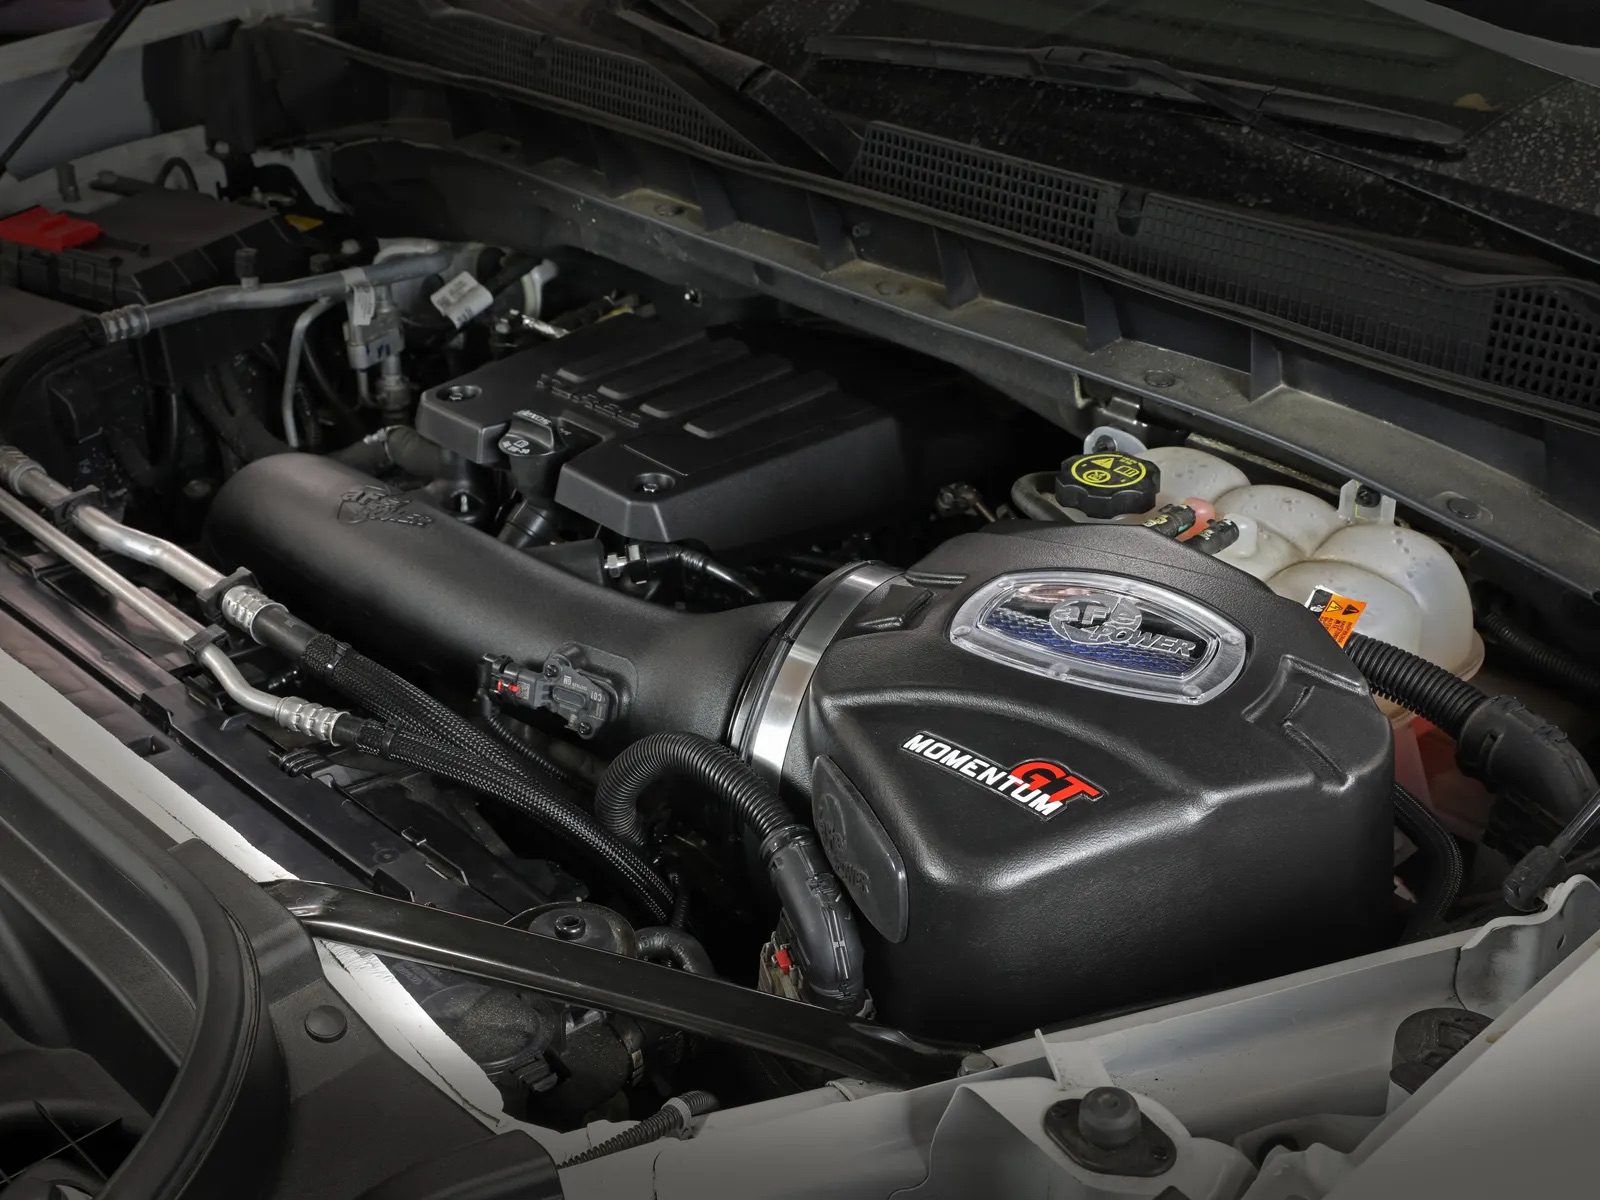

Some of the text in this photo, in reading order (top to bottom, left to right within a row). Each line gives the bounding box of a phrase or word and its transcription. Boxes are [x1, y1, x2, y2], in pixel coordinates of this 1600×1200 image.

[1089, 624, 1197, 658] POWER
[902, 734, 1100, 816] MOMENTUM GT
